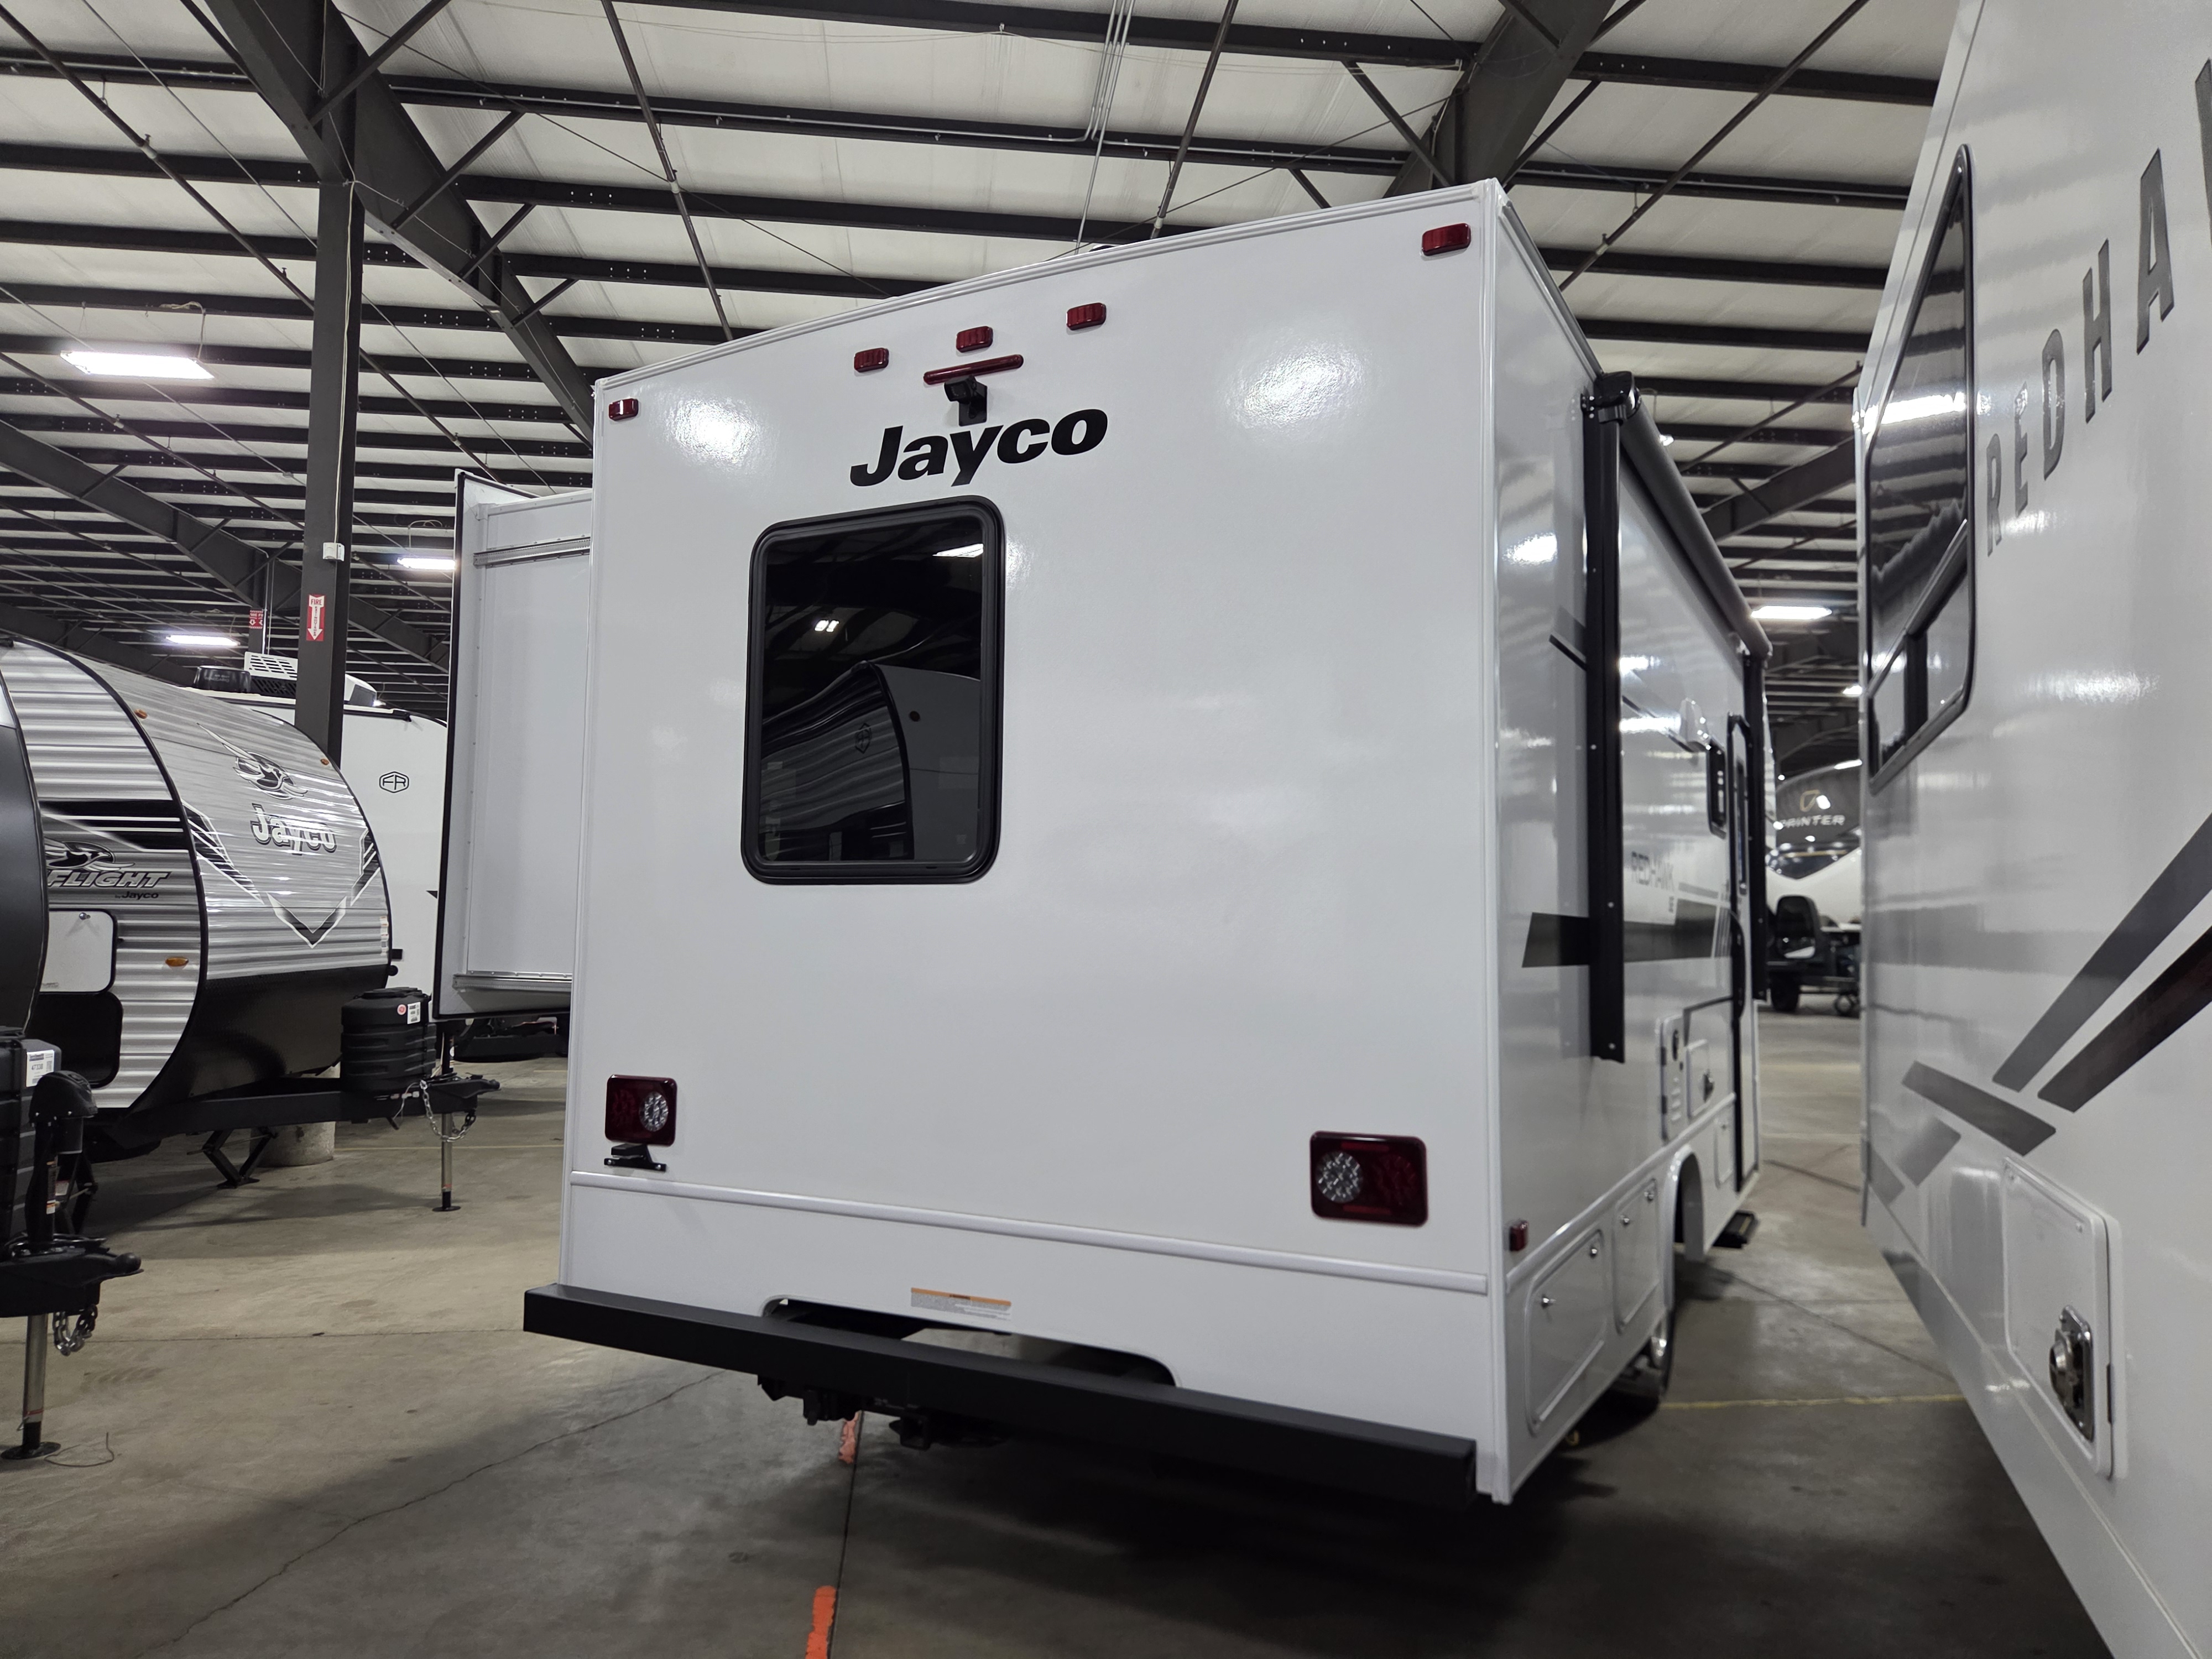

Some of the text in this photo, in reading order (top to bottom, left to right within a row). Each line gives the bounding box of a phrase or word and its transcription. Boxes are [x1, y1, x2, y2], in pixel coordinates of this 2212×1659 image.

[1986, 58, 2212, 556] REDHA
[850, 409, 1108, 487] Jayco
[250, 803, 337, 855] Jayco
[47, 870, 171, 888] FLIGHT
[122, 891, 159, 900] Jayco
